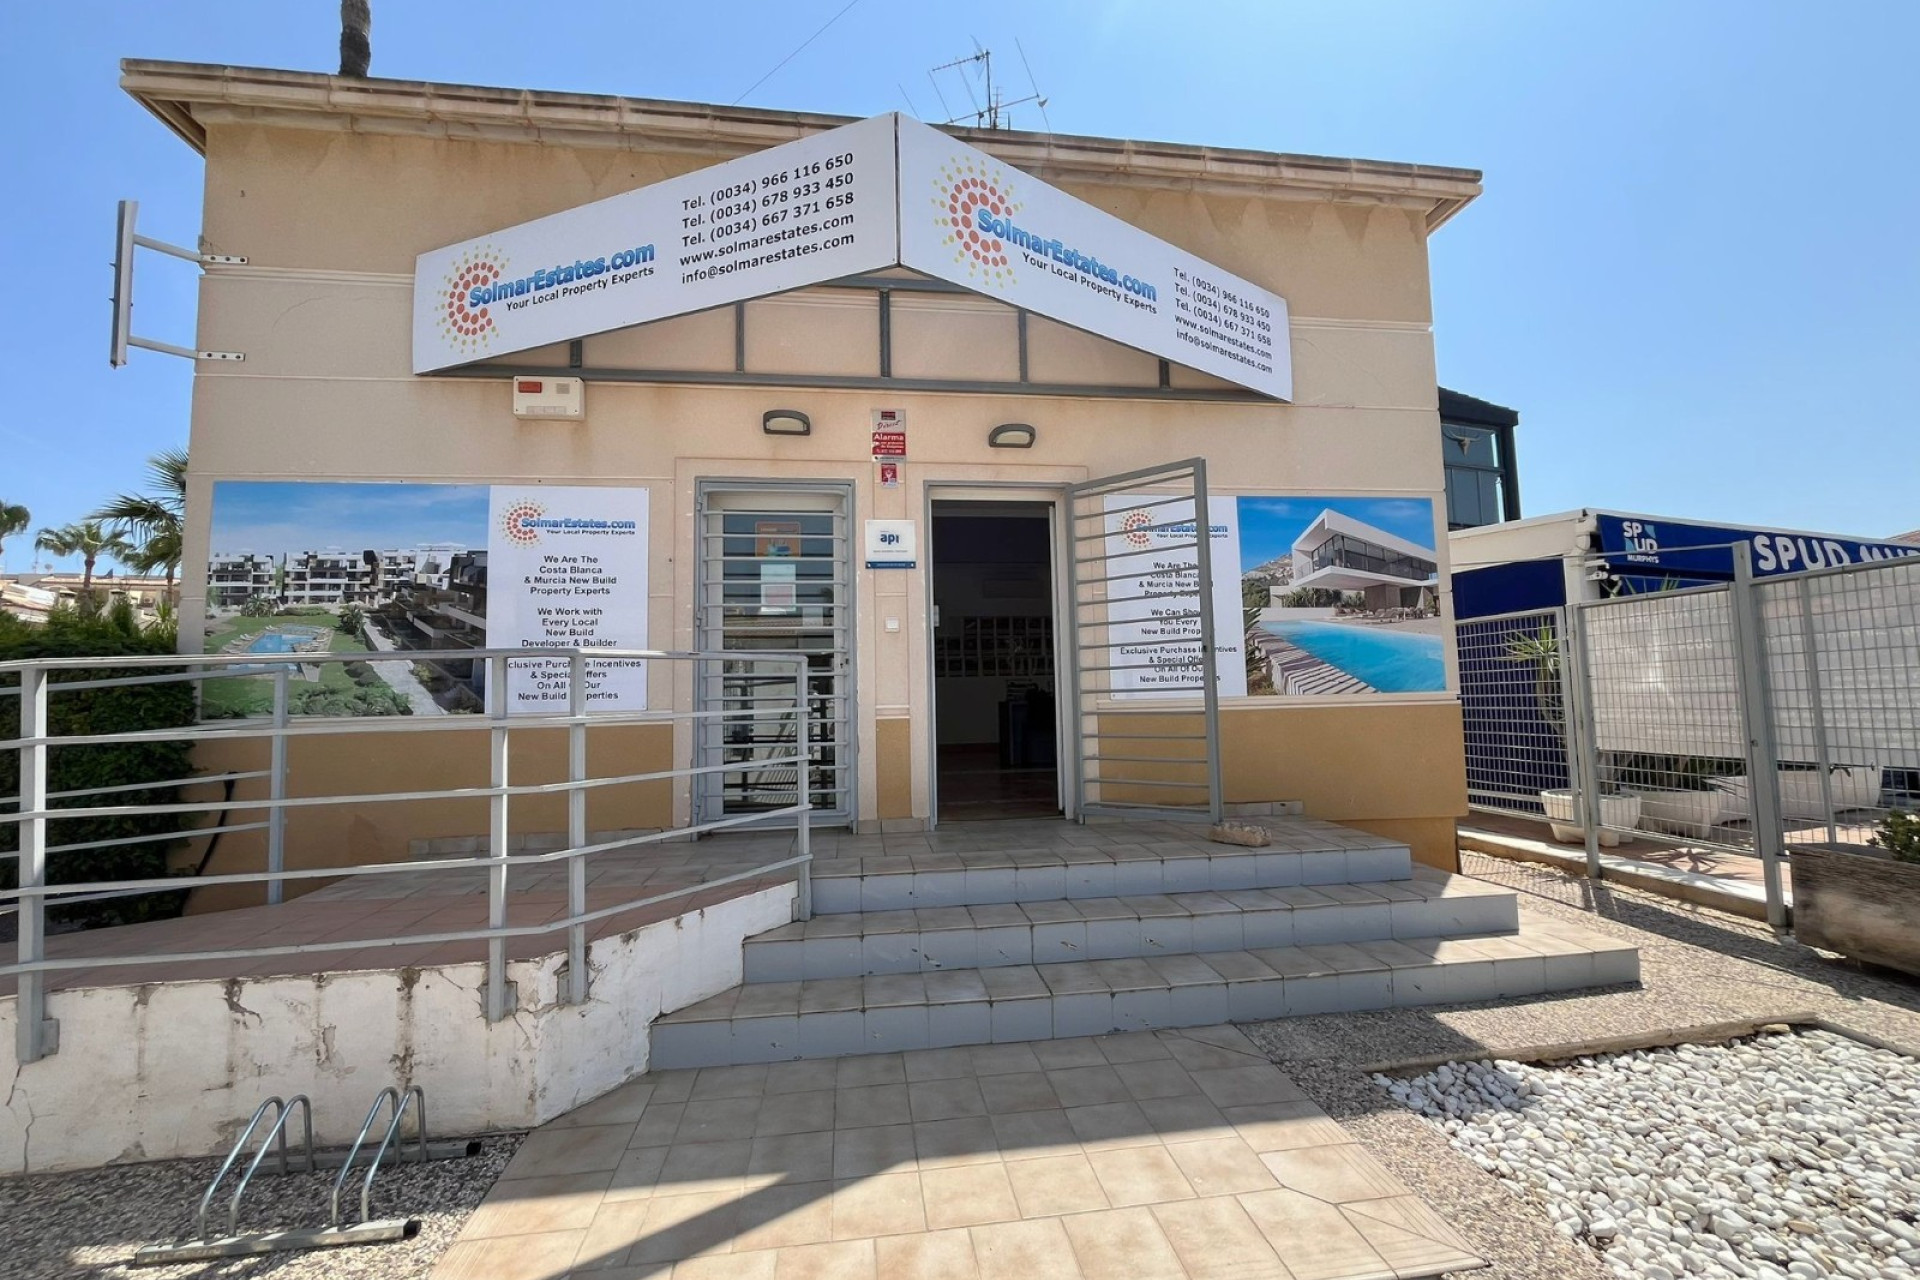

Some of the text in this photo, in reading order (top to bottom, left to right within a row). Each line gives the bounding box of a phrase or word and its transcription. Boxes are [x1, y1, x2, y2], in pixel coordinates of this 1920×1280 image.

[682, 152, 853, 211] Tel. (0034) 966 116 650
[682, 172, 854, 229] Tel. (0034) 678 933 450
[682, 191, 854, 247] Tel. (0034) 667 371 658
[679, 213, 854, 267] www.solmarestates.com
[681, 233, 855, 285] info@solmarestates.com
[977, 208, 1157, 302] SolmarEstates.com
[469, 243, 655, 308] SolmarEstates.com
[1022, 251, 1157, 315] Your Local Property Experts
[506, 266, 655, 312] Your Local Property Experts
[1173, 267, 1270, 318] Tel. (0034) 966 116 650
[1174, 282, 1271, 332] Tel. (0034) 678 933 450
[1175, 298, 1272, 346] Tel. (0034) 667 371 658
[1174, 314, 1273, 360] www.solmarestates.com
[1176, 328, 1273, 374] info@solmarestates.com
[874, 432, 904, 441] Alarma
[521, 518, 636, 529] SolmarEstates.com
[1753, 534, 1850, 571] SPUD
[544, 555, 599, 563] We Are The
[539, 566, 603, 574] Costa Blanca
[1152, 561, 1166, 569] We
[1167, 561, 1181, 569] Are
[523, 576, 617, 584] & Murcia New Build
[1138, 580, 1145, 588] &
[1146, 580, 1172, 588] Murcia
[1174, 580, 1192, 588] New
[529, 586, 611, 596] Property Experts
[537, 607, 603, 616] We Work with
[1150, 608, 1164, 616] We
[1164, 608, 1181, 616] Can
[541, 618, 599, 628] Every Local
[545, 628, 595, 637] New Build
[1141, 627, 1159, 635] New
[1160, 627, 1181, 635] Build
[521, 639, 618, 648] Developer & Builder
[1120, 646, 1159, 655] Exclusive
[1160, 645, 1197, 654] Purchase
[508, 660, 543, 669] clusive
[593, 659, 642, 668] Incentives
[1148, 656, 1155, 664] &
[1156, 656, 1186, 665] Special
[529, 671, 538, 679] &
[586, 670, 608, 679] ffers
[1139, 675, 1157, 683] New
[1158, 675, 1180, 683] Build
[537, 681, 551, 690] On
[553, 681, 566, 689] All
[518, 692, 619, 701] New Build perties
